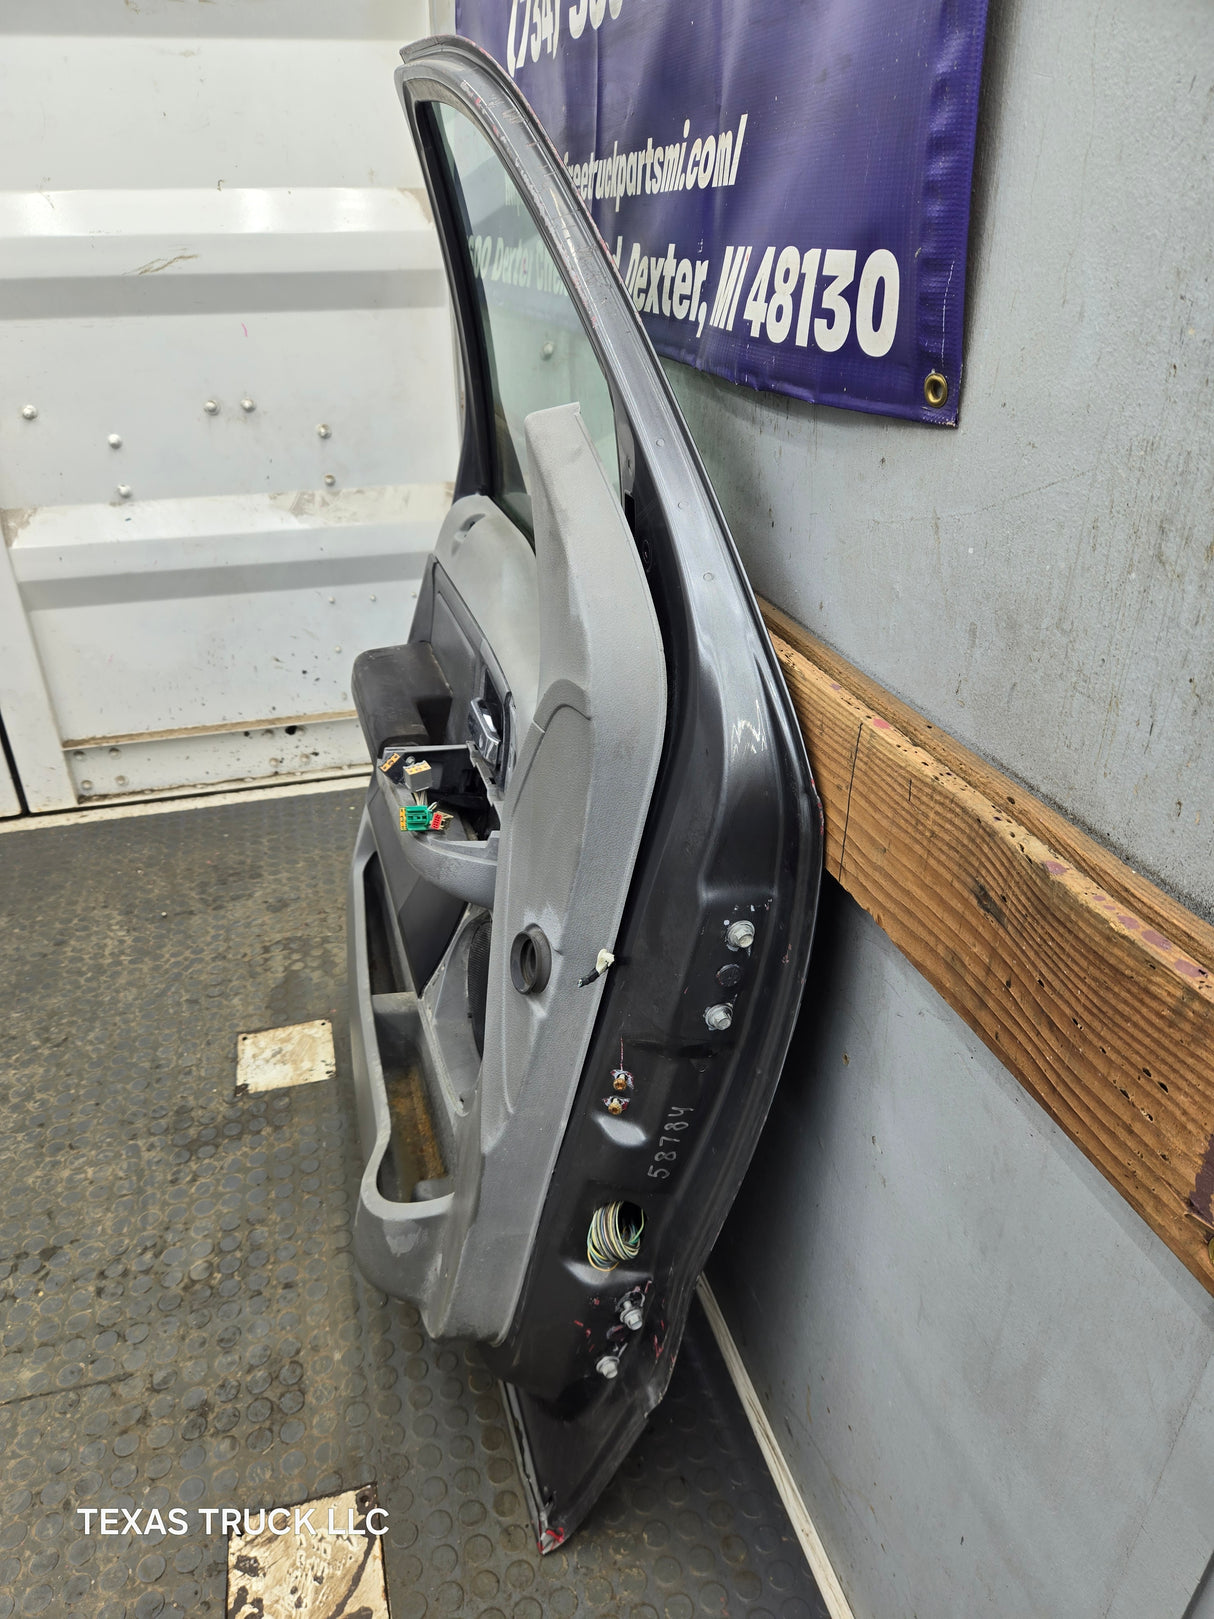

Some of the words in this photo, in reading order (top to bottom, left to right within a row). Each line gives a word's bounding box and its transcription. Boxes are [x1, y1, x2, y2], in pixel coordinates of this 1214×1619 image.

[625, 242, 711, 338] Dexter,
[709, 245, 753, 332] MI
[743, 245, 900, 358] 48130
[648, 1106, 694, 1179] 58784
